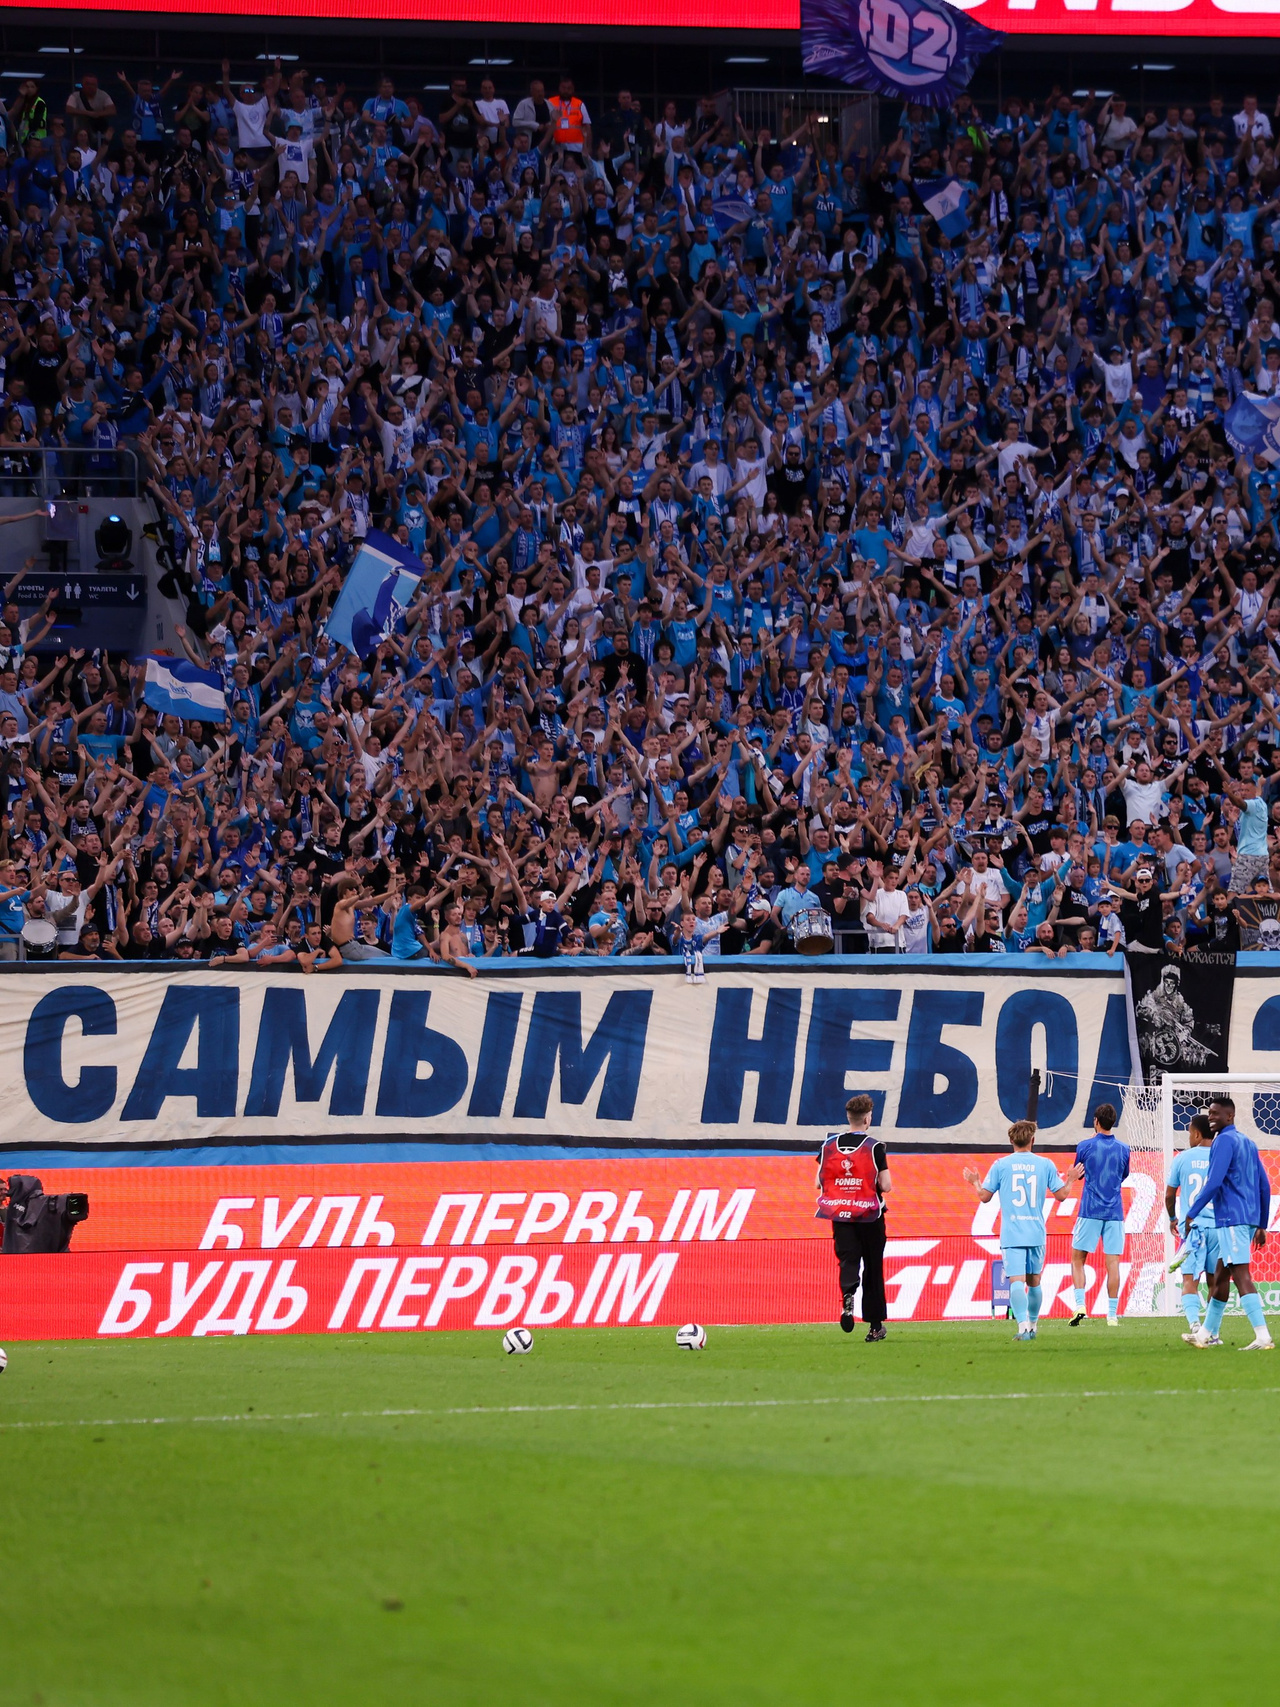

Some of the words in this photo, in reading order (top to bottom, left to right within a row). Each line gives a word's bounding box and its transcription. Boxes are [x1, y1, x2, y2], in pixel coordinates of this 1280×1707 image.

[24, 985, 653, 1123] САМЫМ
[1191, 1160, 1210, 1170] ПЕДР
[835, 1177, 863, 1187] FONBET
[1010, 1174, 1036, 1208] 51
[839, 1211, 852, 1219] 012
[97, 1259, 308, 1336] БУДЬ
[327, 1252, 680, 1329] ПЕРВЫМ
